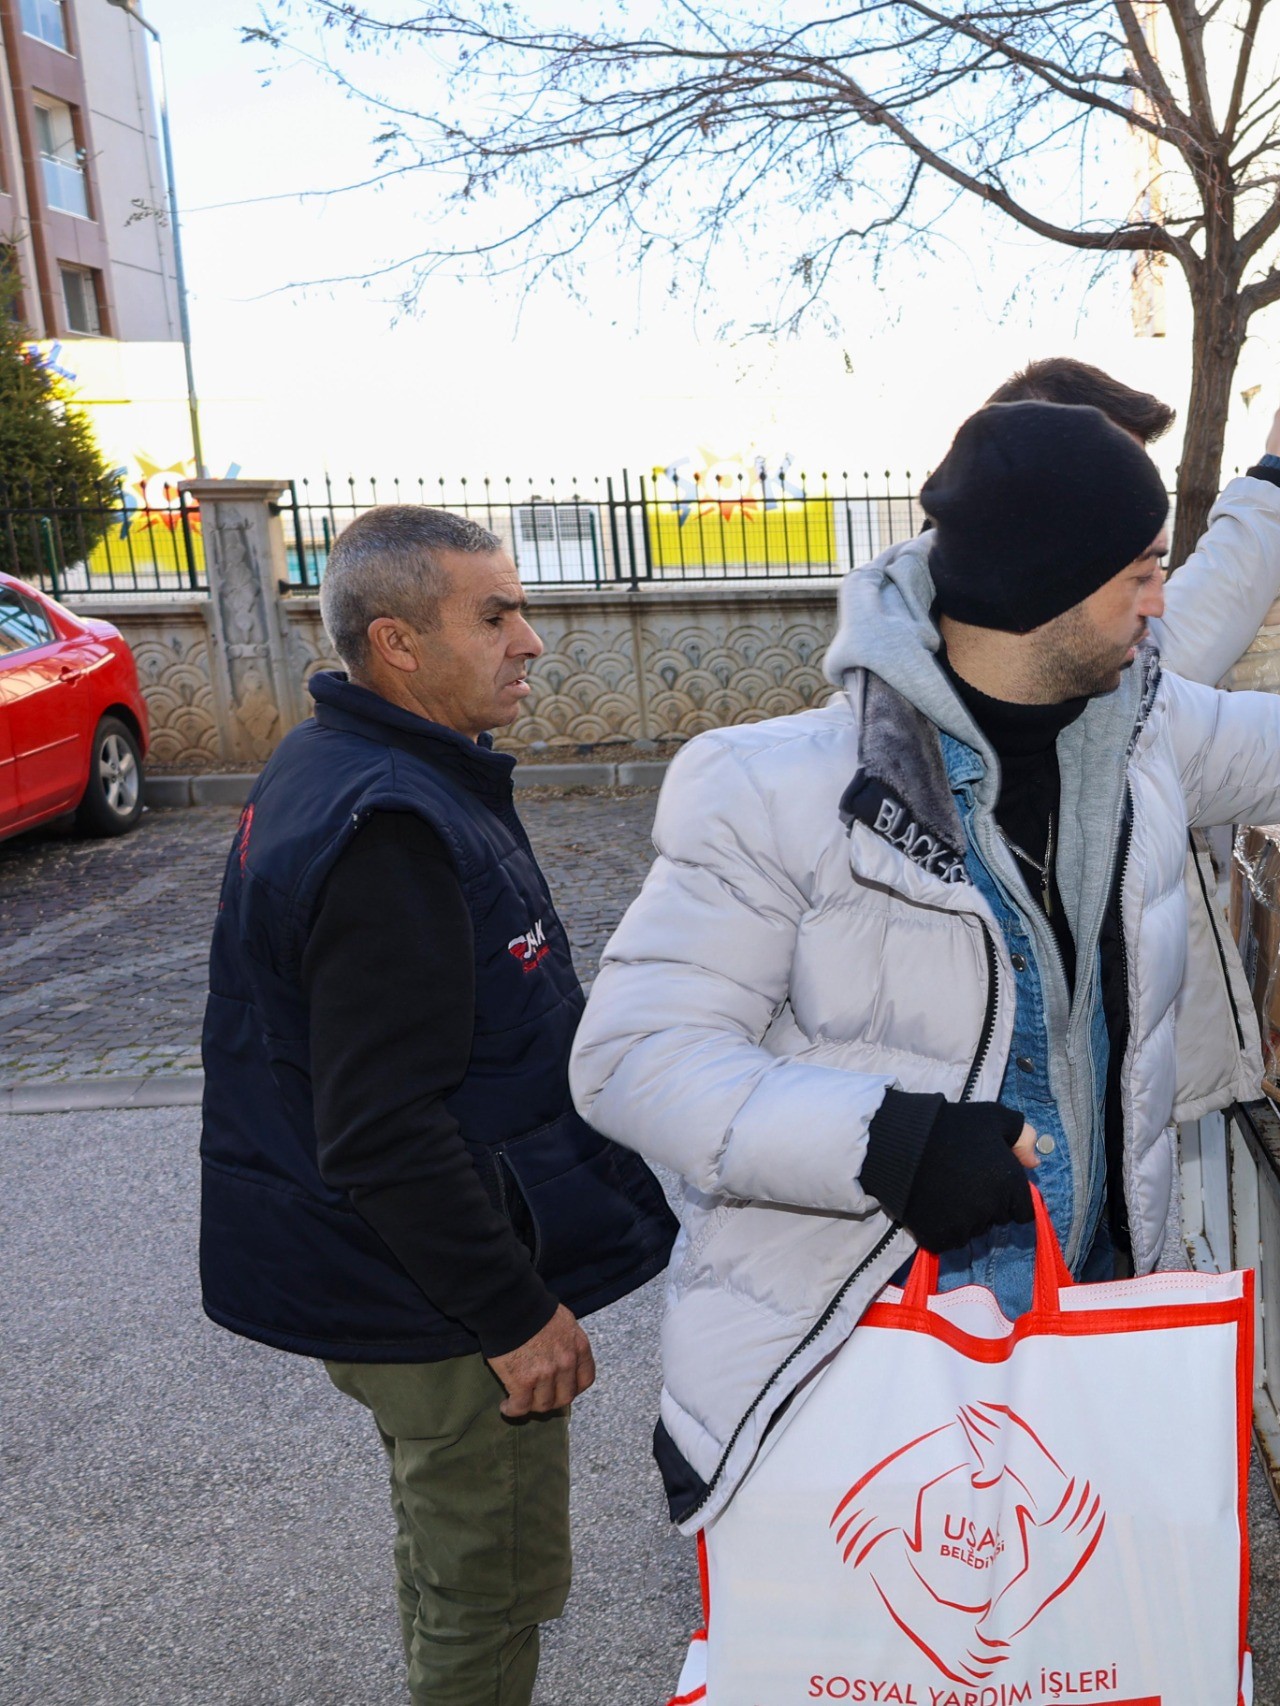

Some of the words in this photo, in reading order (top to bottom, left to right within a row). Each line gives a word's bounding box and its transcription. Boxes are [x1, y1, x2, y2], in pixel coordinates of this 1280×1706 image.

[808, 1675, 918, 1705] SOSYAL
[928, 1680, 1033, 1706] YARDIM
[1041, 1663, 1117, 1699] İŞLERİ
